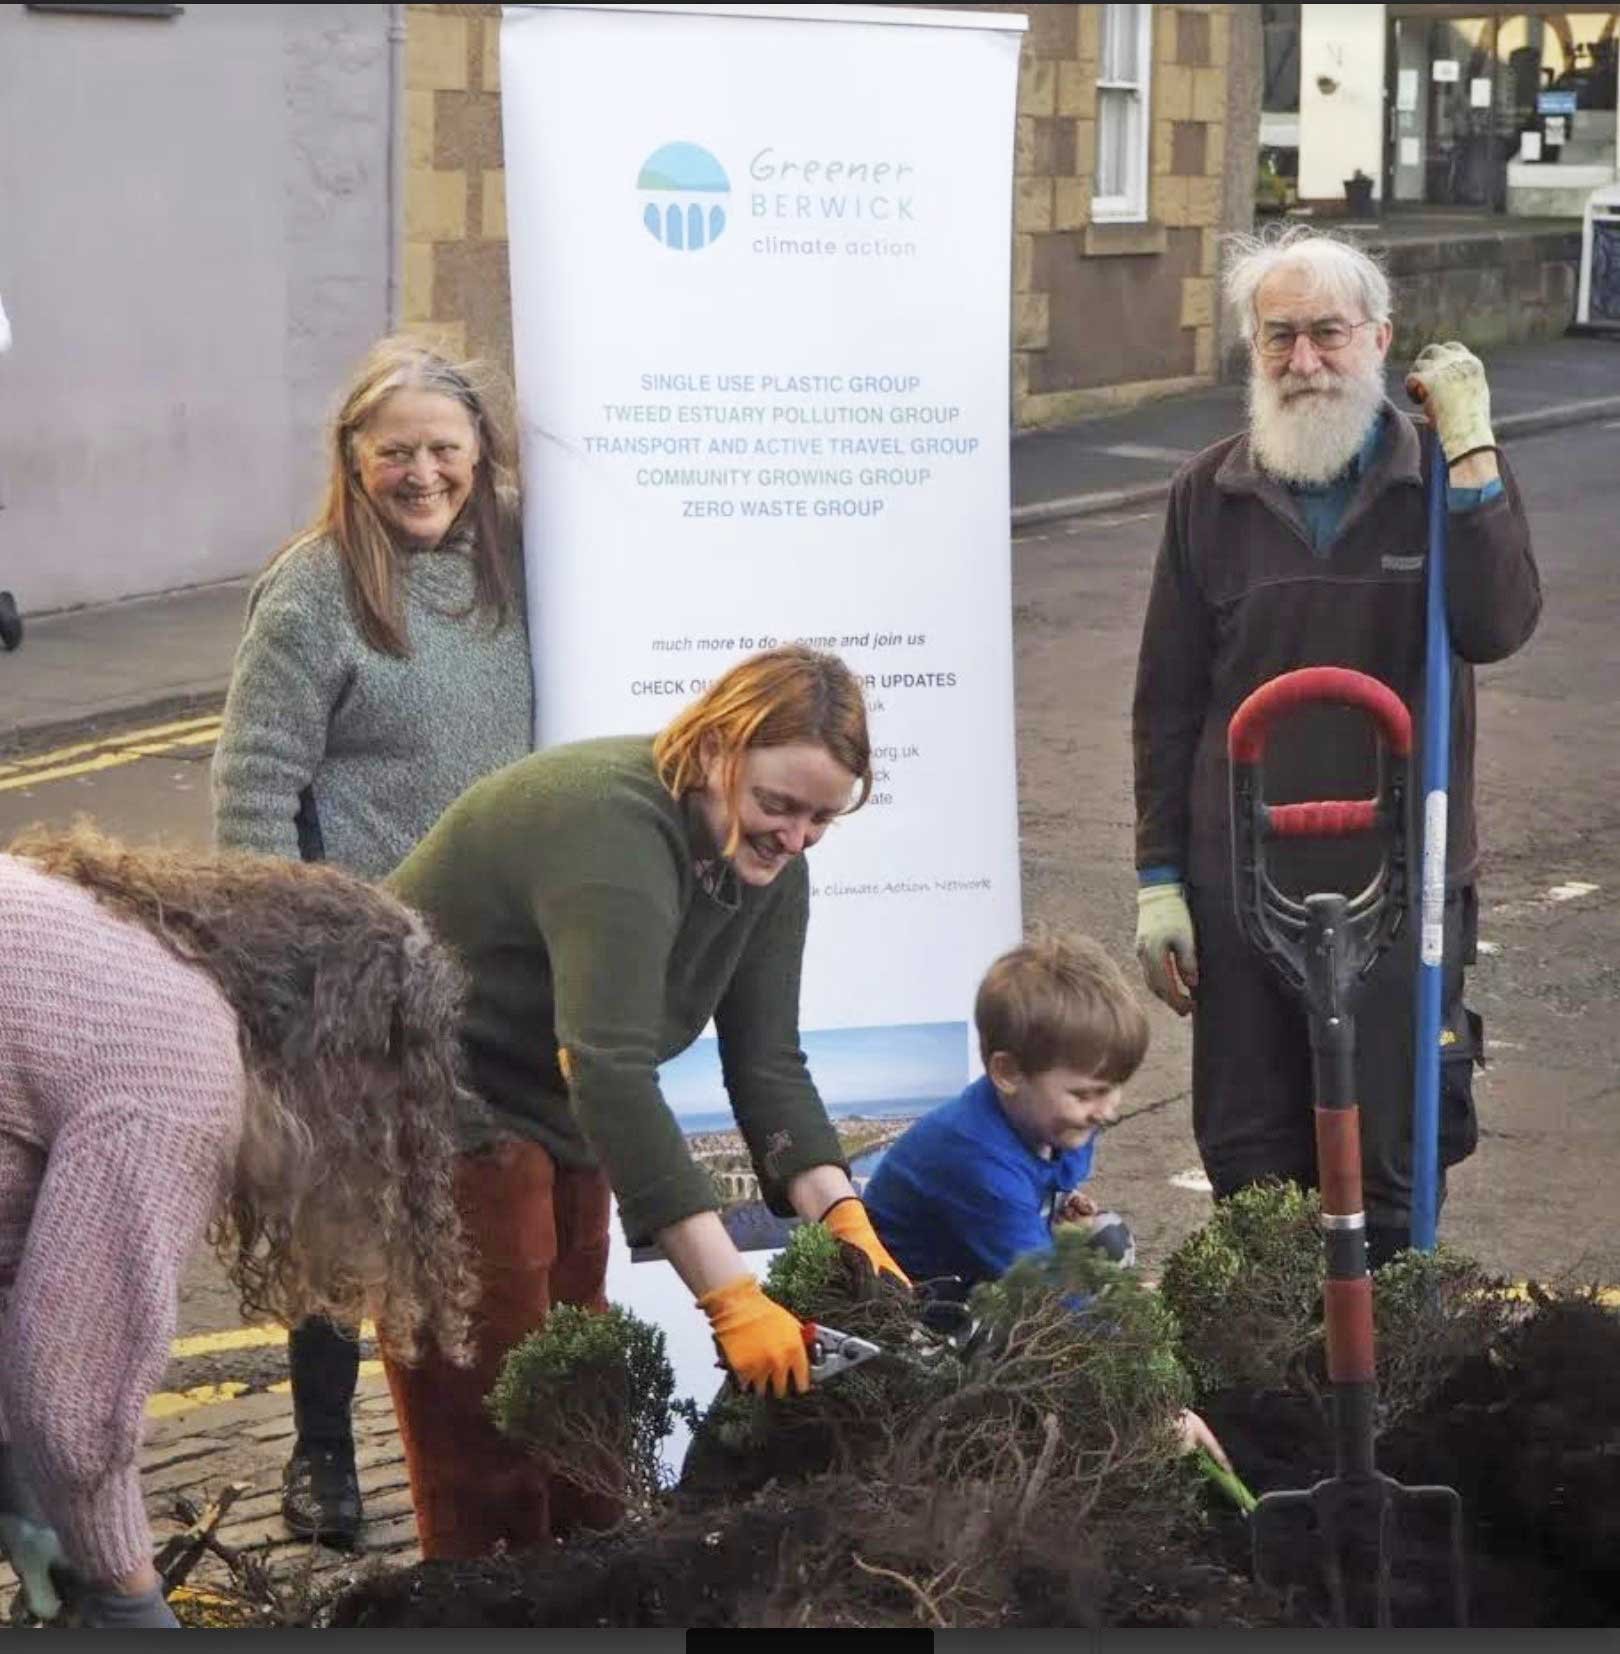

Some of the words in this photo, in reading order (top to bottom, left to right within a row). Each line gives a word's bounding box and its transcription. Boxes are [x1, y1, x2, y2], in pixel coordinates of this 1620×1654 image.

[749, 146, 914, 184] Greener
[751, 193, 914, 221] BERWICK
[752, 236, 837, 256] climate
[845, 239, 916, 257] action
[641, 374, 711, 393] SINGLE
[717, 375, 755, 393] USE
[761, 375, 843, 393] PLASTIC
[849, 375, 921, 394] GROUP
[603, 405, 672, 423] TWEED
[678, 406, 766, 424] ESTUARY
[772, 406, 884, 425] POLLUTION
[890, 407, 960, 425] GROUP
[583, 436, 701, 455] TRANSPORT
[708, 437, 748, 455] AND
[753, 437, 823, 455] ACTIVE
[829, 437, 904, 455] TRAVEL
[910, 437, 980, 455] GROUP
[636, 468, 752, 487] COMMUNITY
[758, 468, 853, 487] GROWING
[859, 468, 932, 487] GROUP
[682, 500, 734, 518] ZERO
[740, 499, 808, 518] WASTE
[813, 499, 885, 518] GROUP
[652, 637, 693, 651] much
[697, 638, 735, 651] more
[739, 636, 754, 649] to
[758, 635, 777, 649] do
[795, 635, 837, 648] come
[841, 633, 870, 647] and
[873, 632, 902, 650] join
[907, 634, 926, 646] us
[631, 680, 685, 696] CHECK
[881, 672, 957, 689] UPDATES
[883, 879, 931, 893] Action
[935, 877, 991, 891] Network
